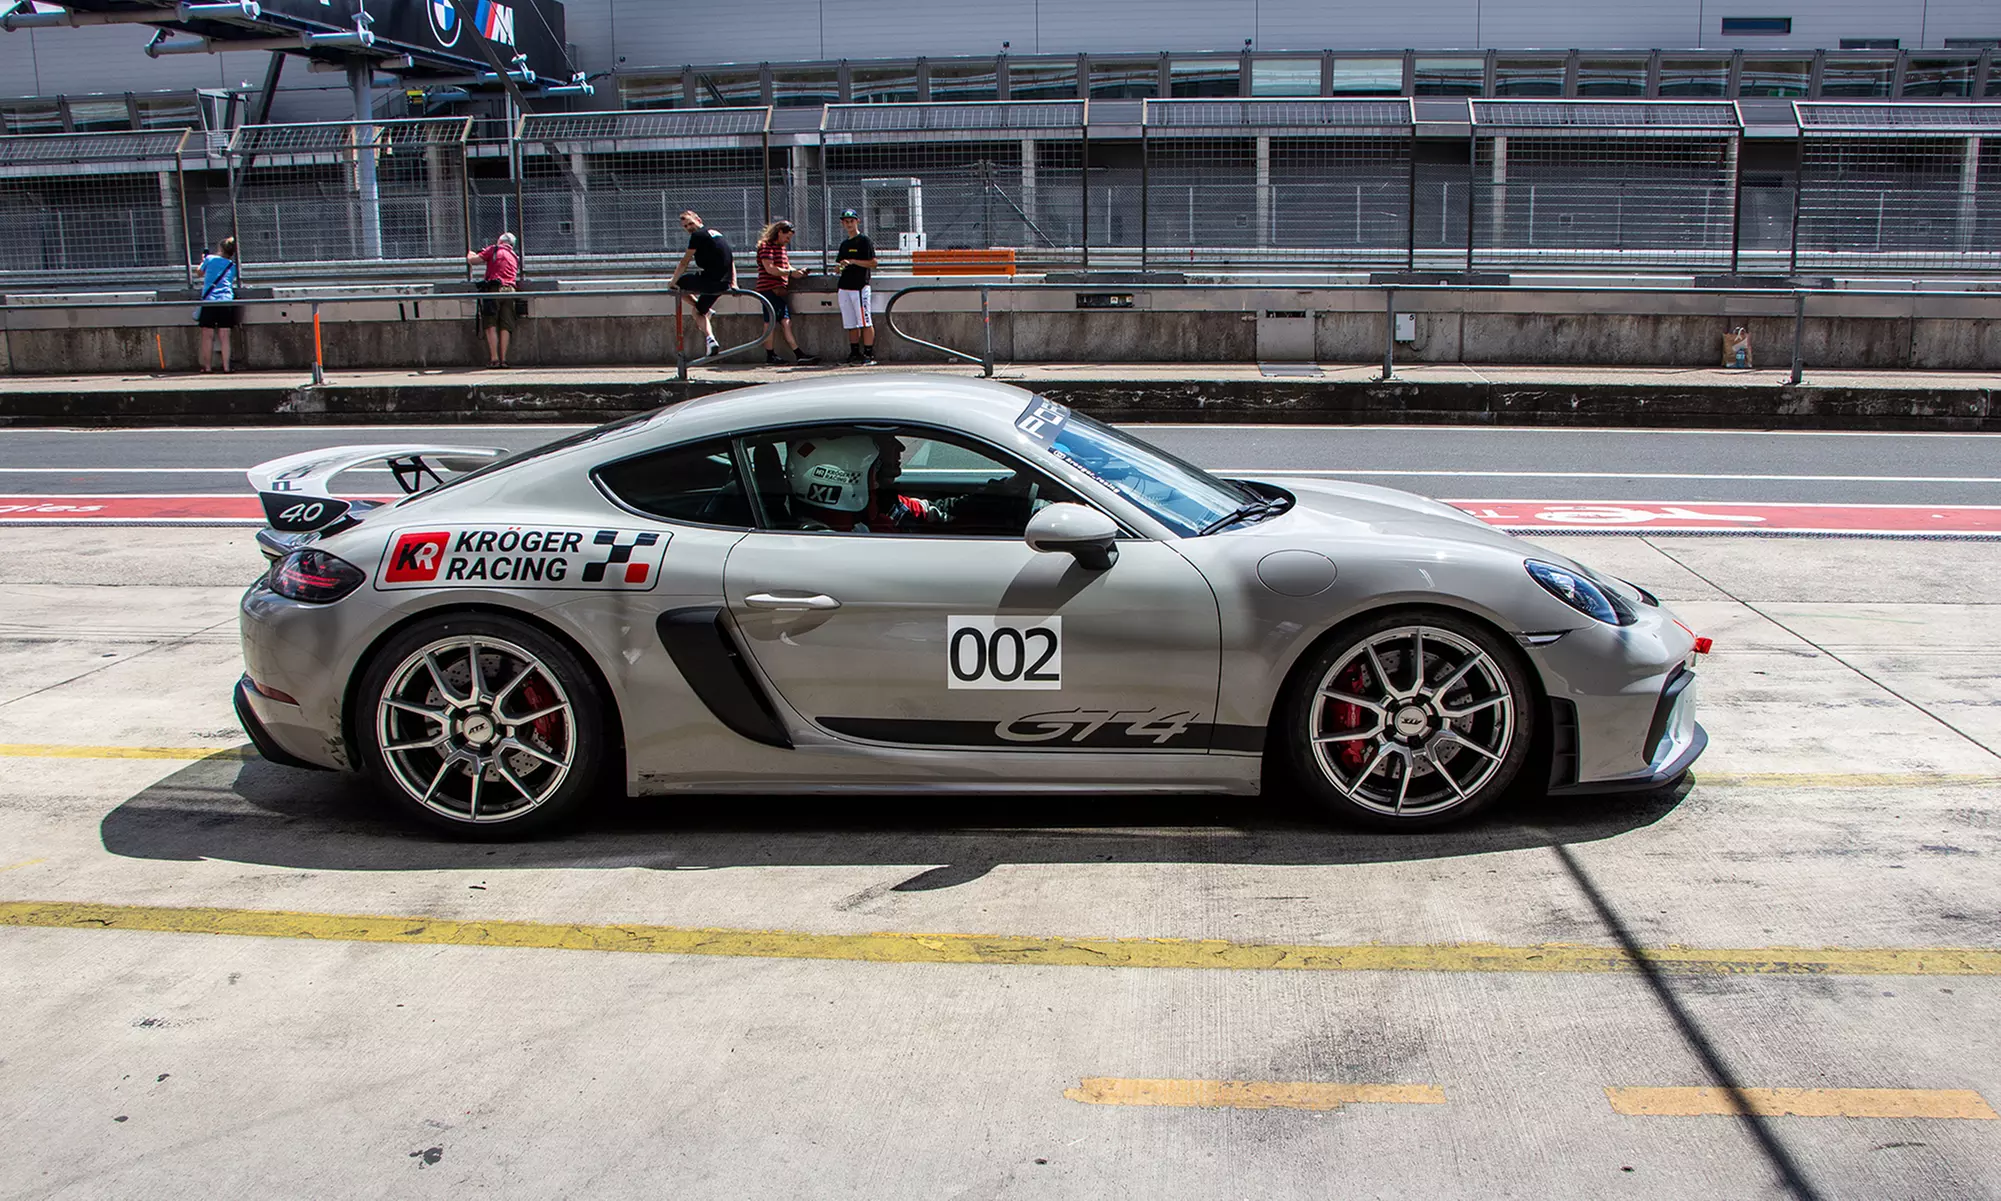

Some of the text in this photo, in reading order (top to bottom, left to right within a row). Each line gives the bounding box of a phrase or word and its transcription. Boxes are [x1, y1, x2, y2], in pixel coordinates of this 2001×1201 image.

[809, 484, 837, 503] XL
[279, 502, 324, 523] 4.0
[454, 526, 584, 553] KRÖGER
[396, 541, 439, 571] KR
[445, 557, 568, 581] RACING
[949, 626, 1060, 682] 002
[994, 707, 1200, 744] GT4
